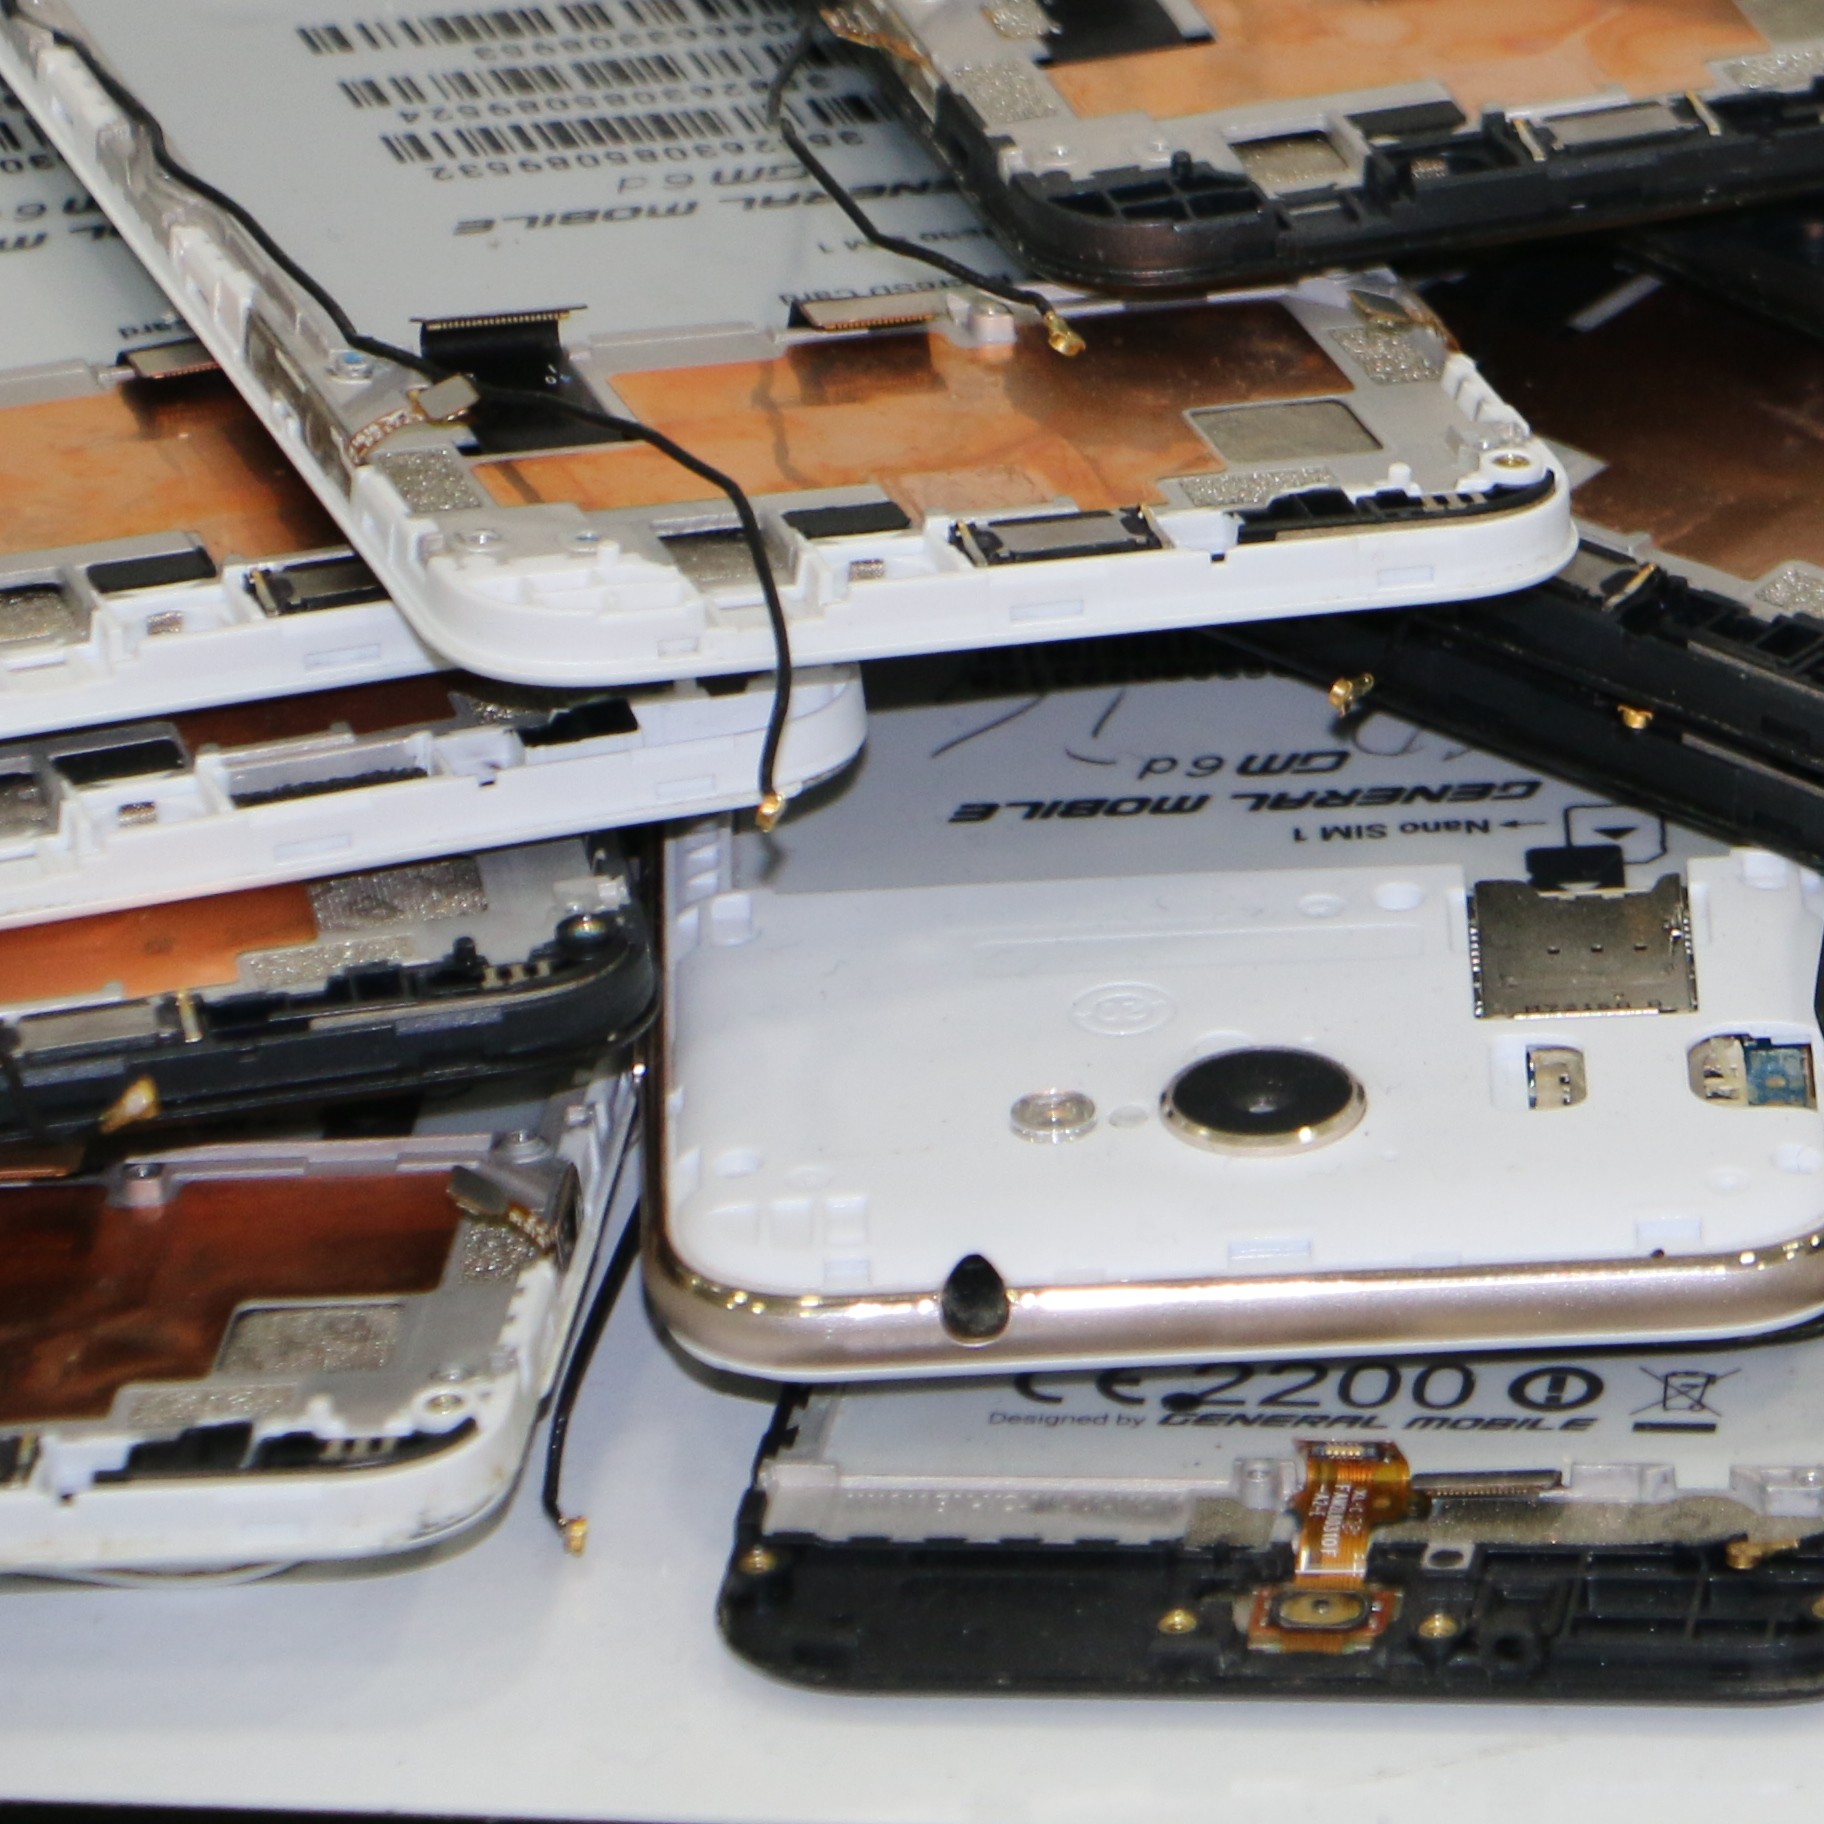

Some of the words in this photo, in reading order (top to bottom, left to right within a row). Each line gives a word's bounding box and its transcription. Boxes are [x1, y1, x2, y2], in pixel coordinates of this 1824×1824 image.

[424, 131, 866, 182] 35263085089532
[452, 202, 699, 237] MOBILE
[946, 792, 1212, 825] MOBILE
[1230, 779, 1543, 813] GENERAL
[1320, 822, 1388, 842] SIM
[1399, 818, 1491, 837] Nano
[987, 1410, 1110, 1429] Designed
[1116, 1410, 1148, 1429] by
[1156, 1411, 1389, 1430] GENERAL
[1403, 1416, 1600, 1433] MOBILE
